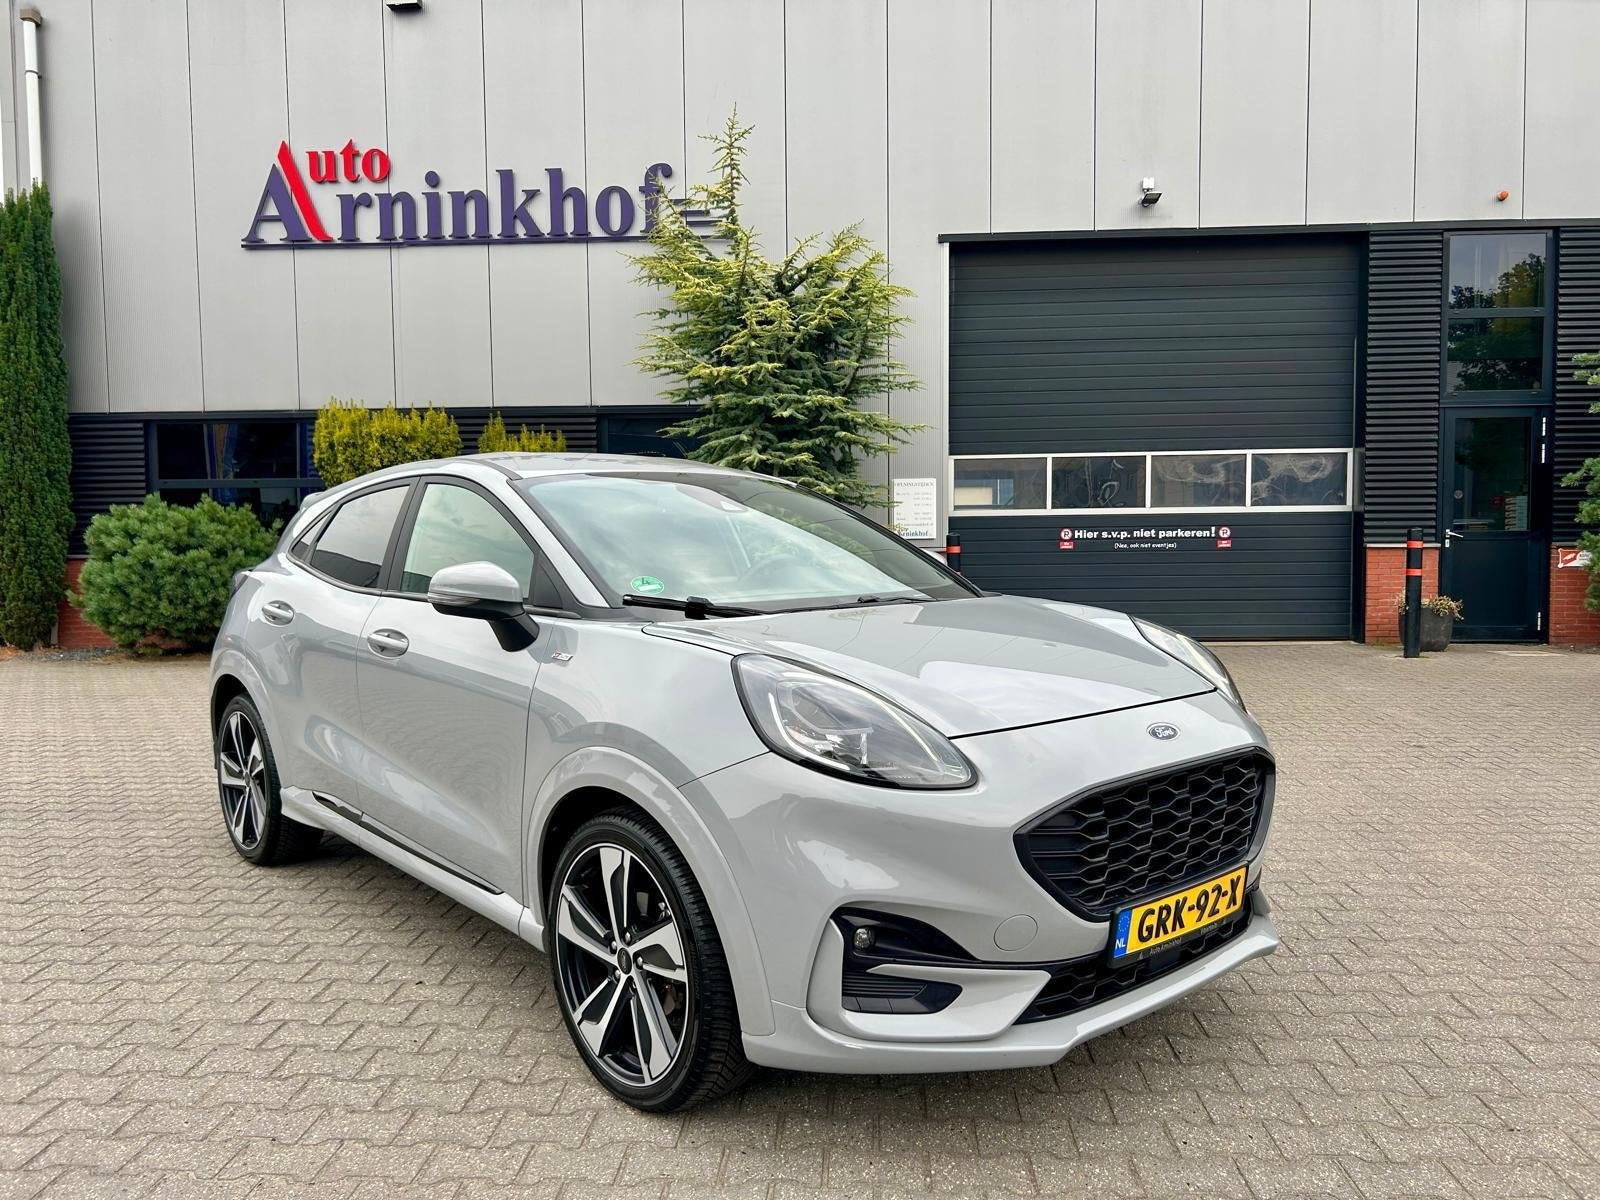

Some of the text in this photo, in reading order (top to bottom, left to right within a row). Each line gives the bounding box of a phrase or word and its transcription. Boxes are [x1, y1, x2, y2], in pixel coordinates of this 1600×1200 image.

[240, 161, 673, 244] Arninkhof
[1074, 526, 1216, 540] Hier s.v.p. niet parkeren!
[1137, 874, 1242, 943] GRK-92-X
[1115, 938, 1126, 949] NL
